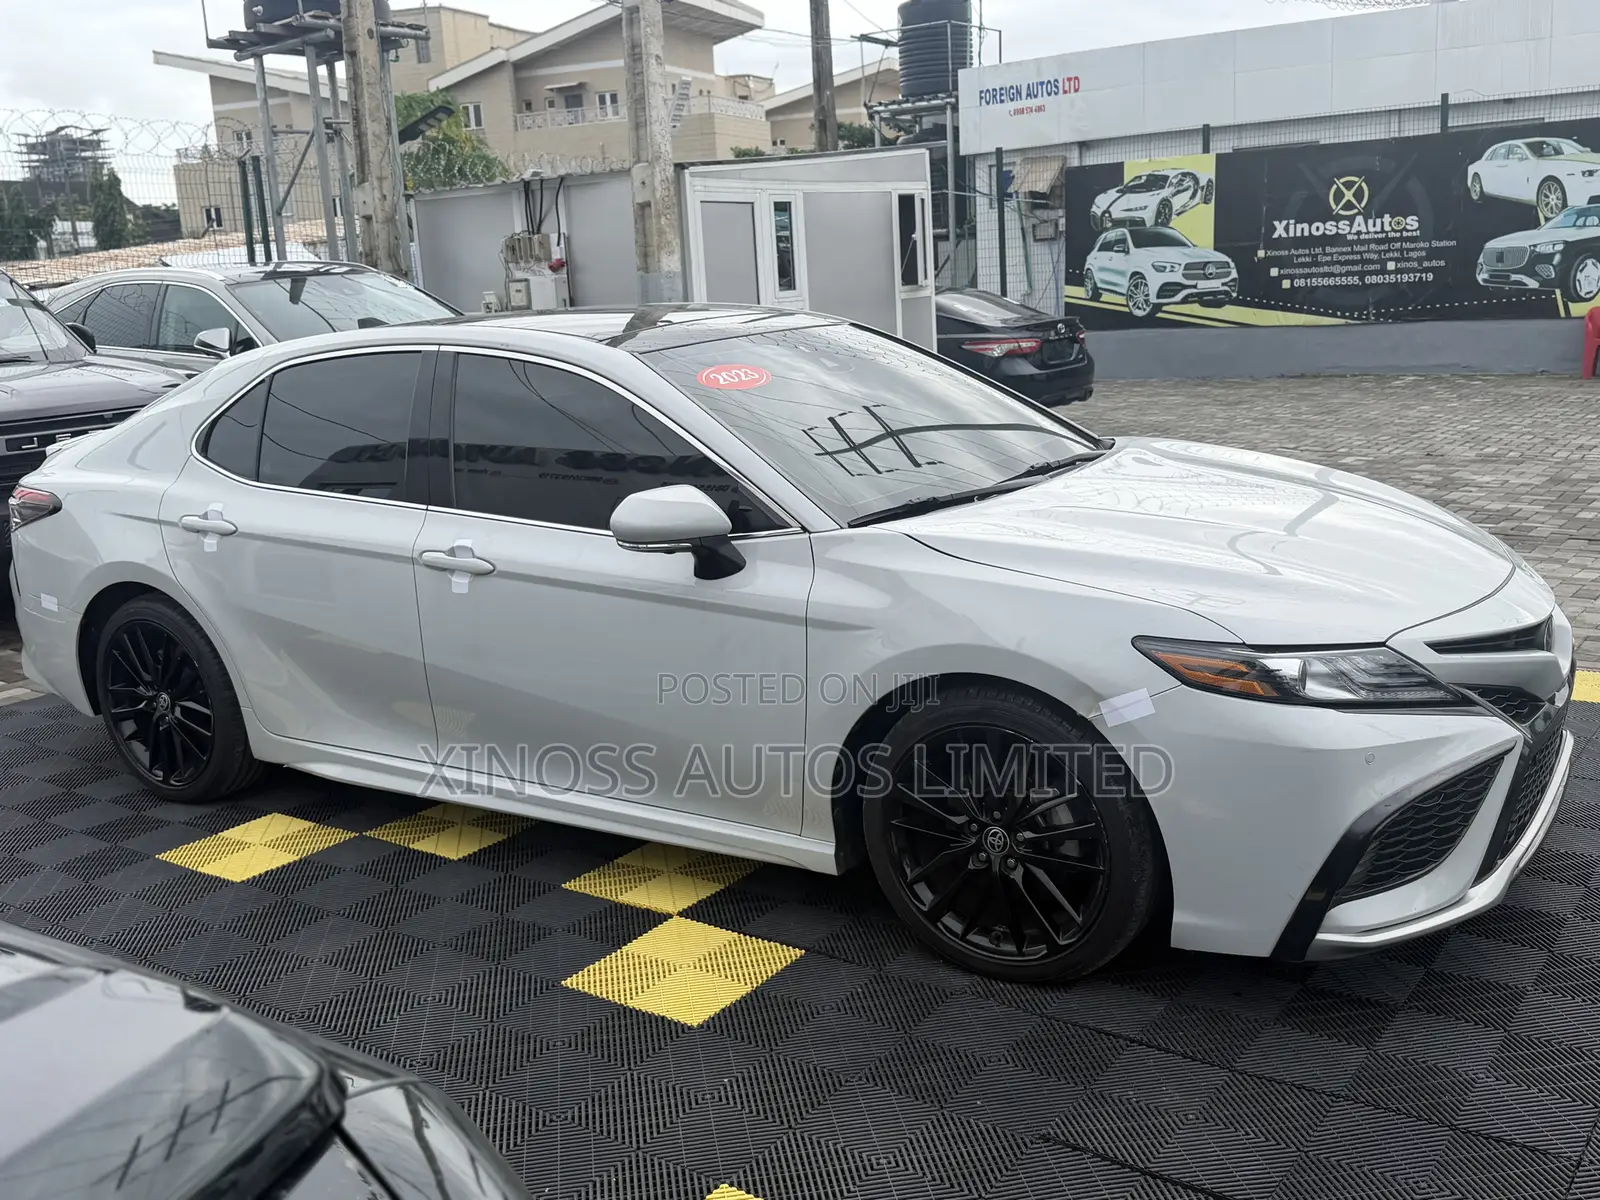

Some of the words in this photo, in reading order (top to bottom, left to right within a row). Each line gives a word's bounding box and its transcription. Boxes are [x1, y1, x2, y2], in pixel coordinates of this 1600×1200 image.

[979, 84, 1022, 106] FOREIGN
[1025, 79, 1059, 100] AUTOS
[1062, 76, 1080, 95] LTD
[1272, 213, 1419, 238] XinossAutos
[1369, 243, 1389, 251] Road
[1402, 241, 1430, 249] Maroko
[1333, 253, 1361, 262] Express
[1403, 250, 1427, 258] Lagos
[1396, 260, 1446, 270] xinos_autos
[1364, 272, 1434, 284] 08035193719
[709, 368, 760, 385] 2023
